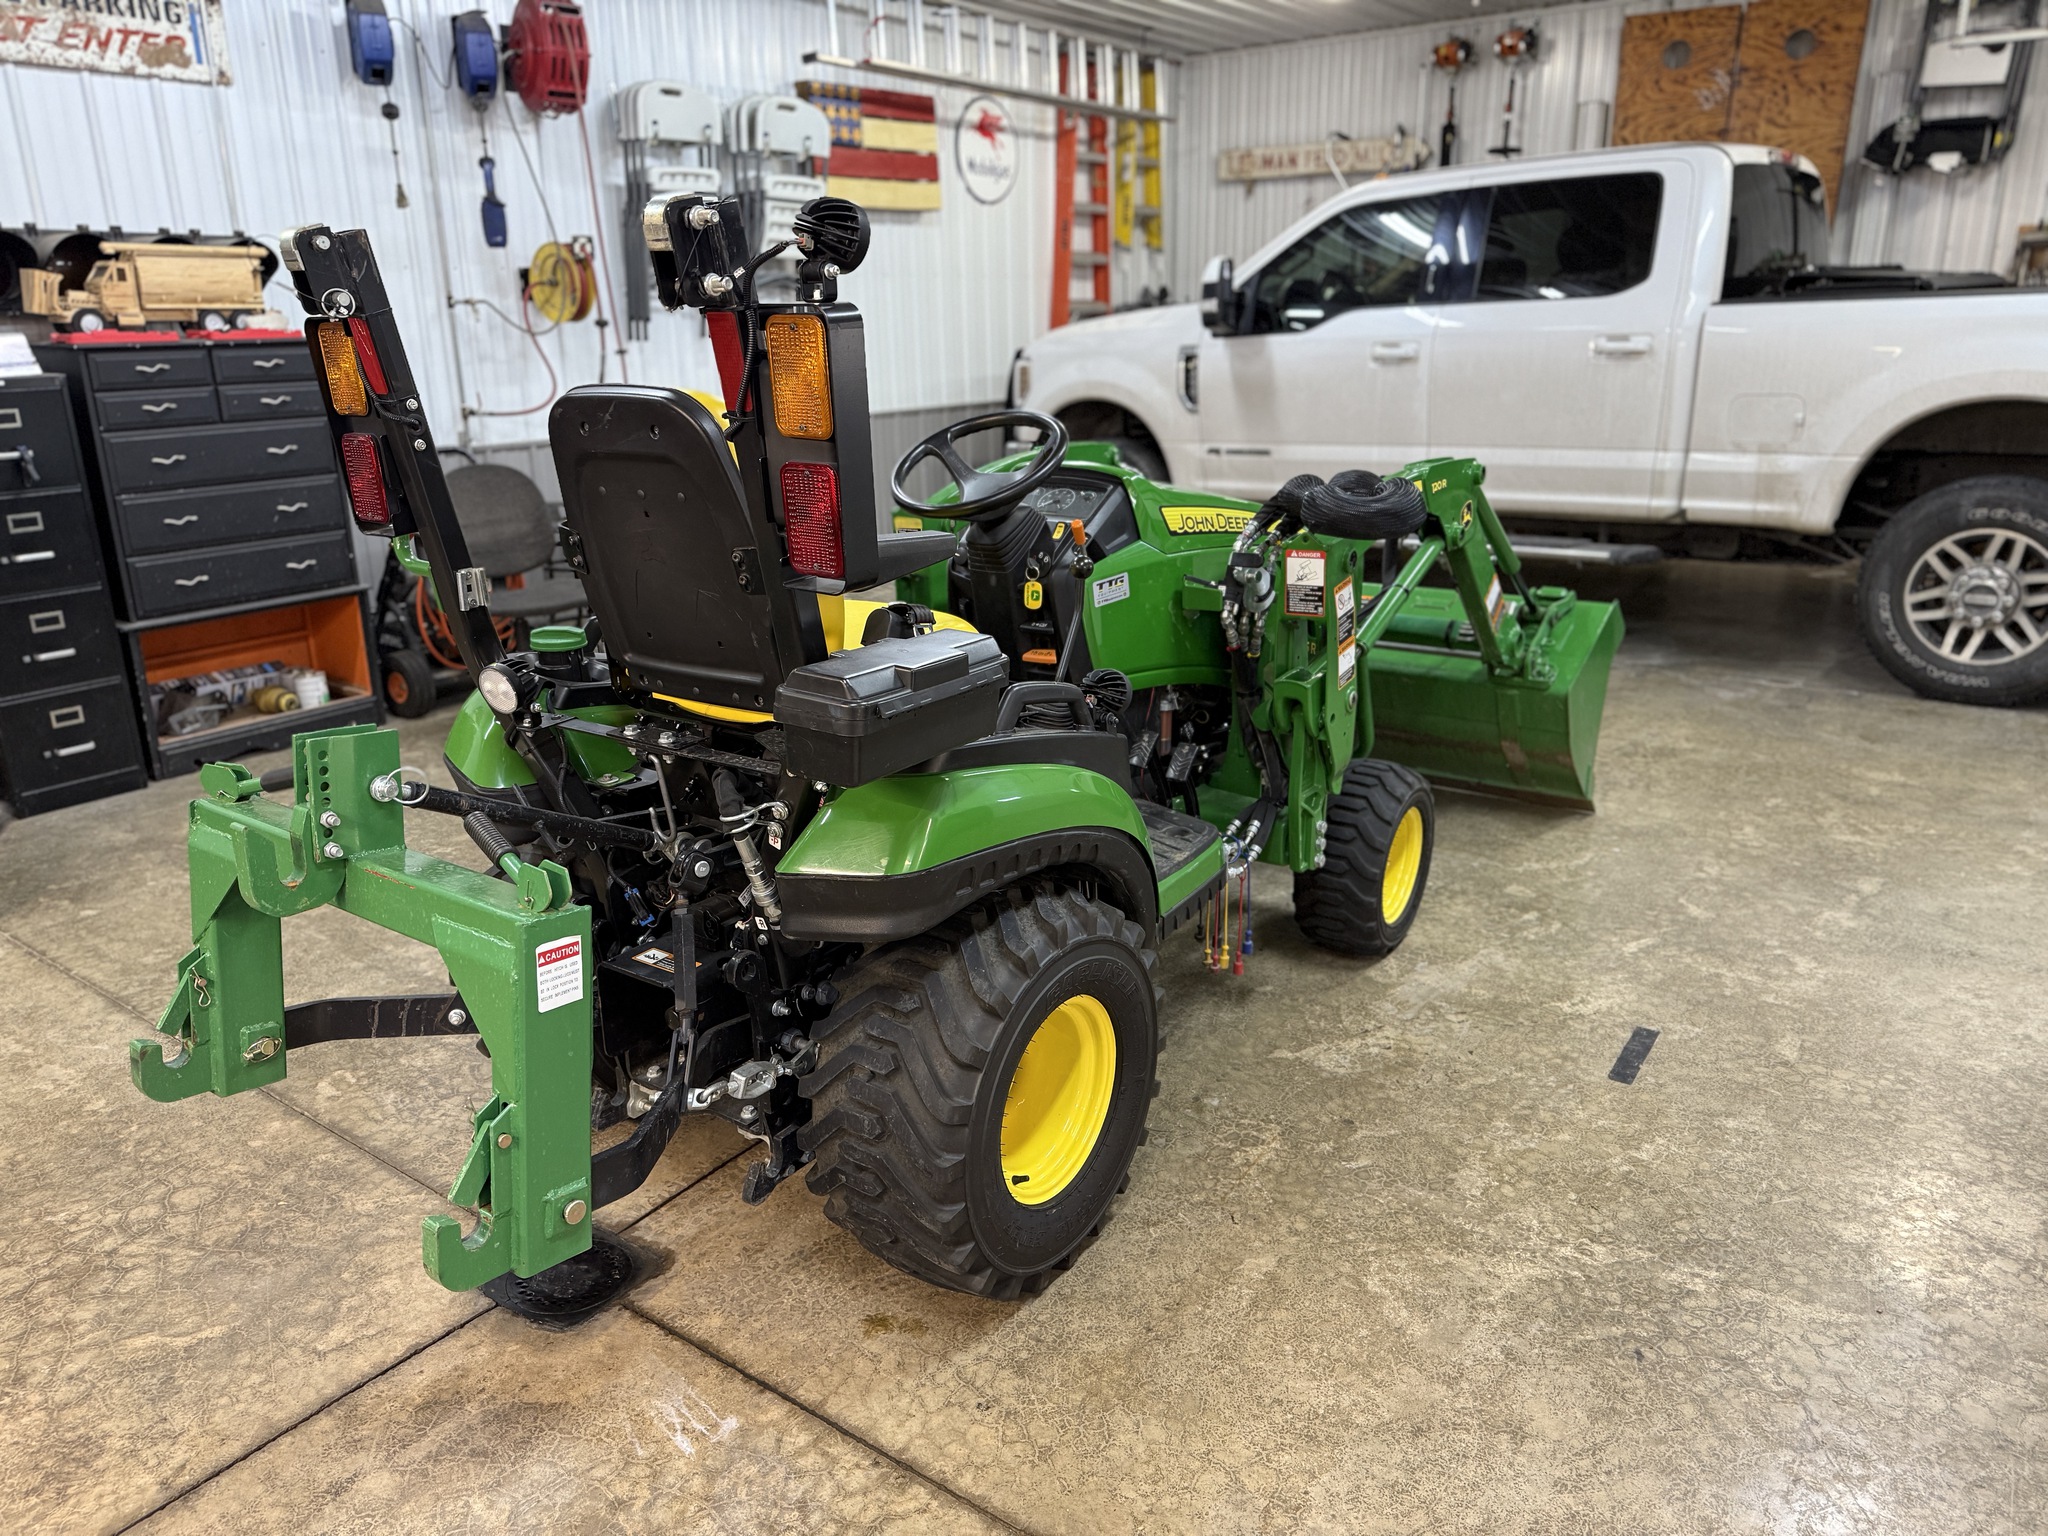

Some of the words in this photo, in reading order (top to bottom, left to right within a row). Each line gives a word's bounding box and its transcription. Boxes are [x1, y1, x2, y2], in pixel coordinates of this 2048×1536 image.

[1178, 513, 1214, 530] JOHN
[1216, 513, 1252, 530] DEER
[1096, 575, 1125, 592] TTG
[546, 945, 579, 962] CAUTION
